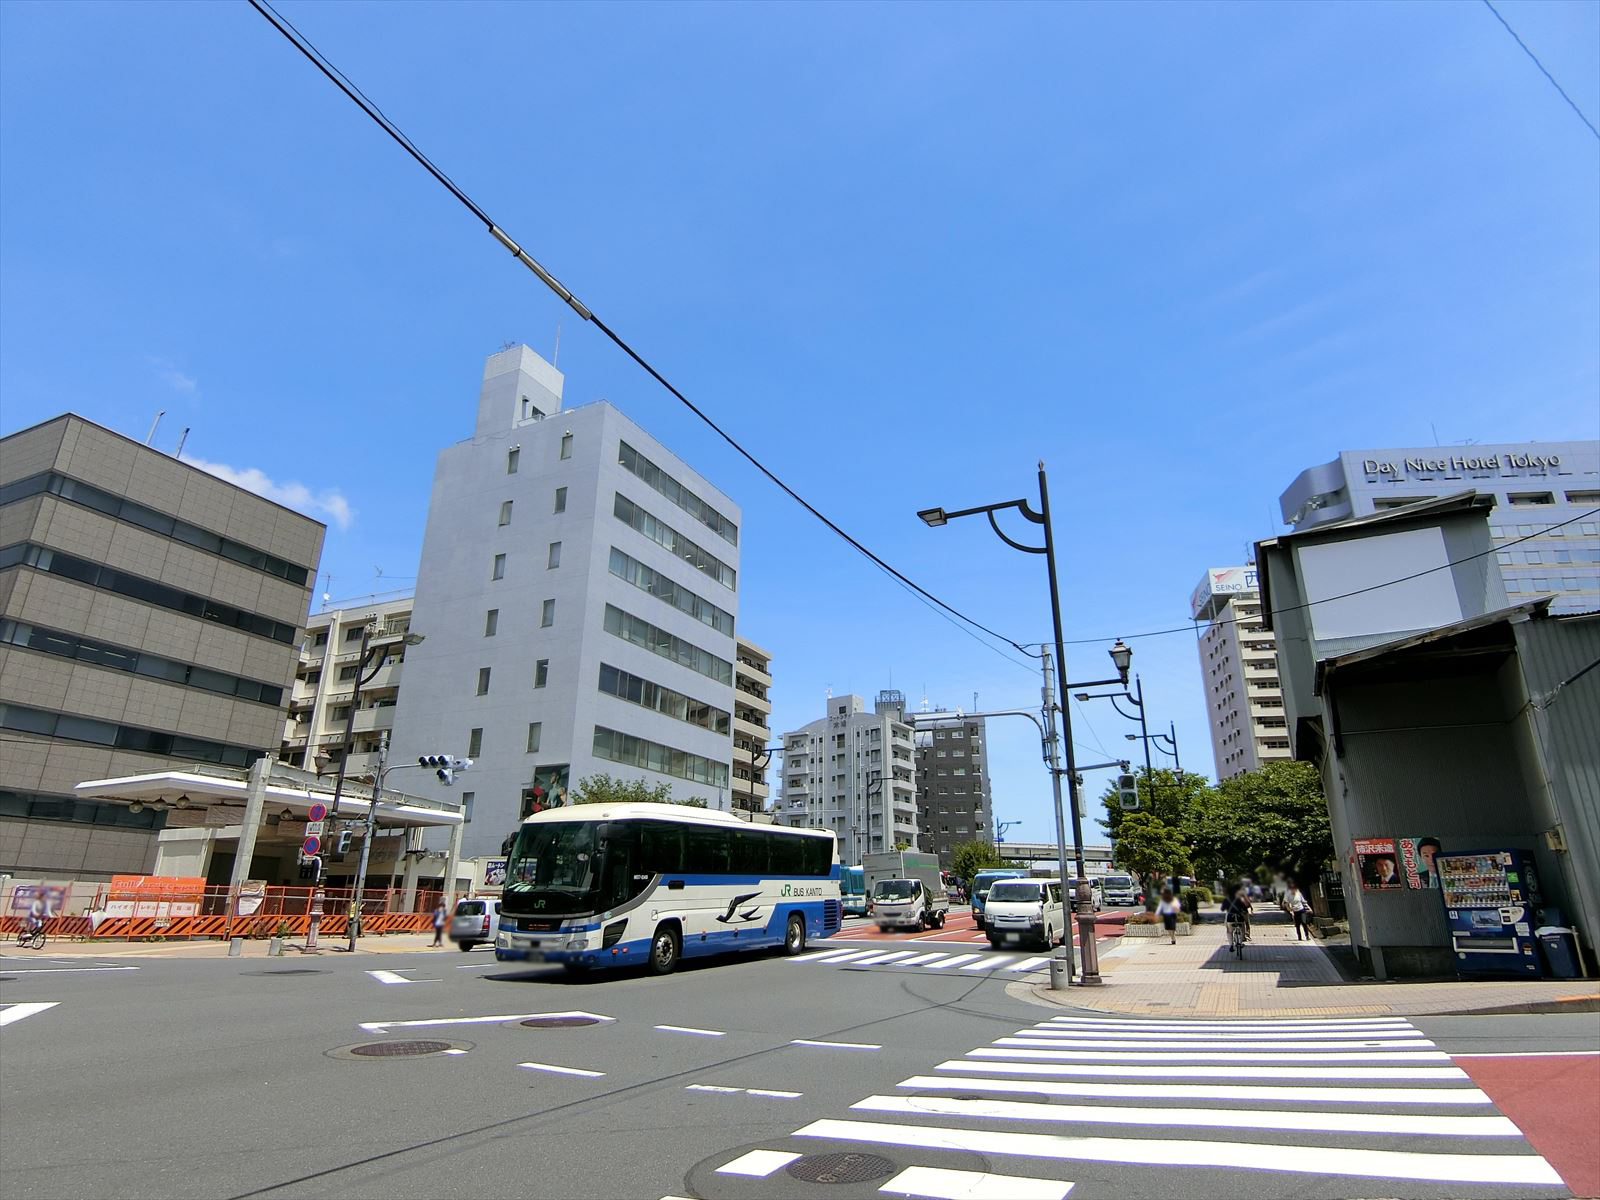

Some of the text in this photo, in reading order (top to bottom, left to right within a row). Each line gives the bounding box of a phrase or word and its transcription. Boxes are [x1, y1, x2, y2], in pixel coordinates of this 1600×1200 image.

[1363, 452, 1562, 479] Day Nice Hotel Tokyo
[1215, 583, 1242, 592] SEINO
[781, 883, 822, 897] JR BUS KANTO
[534, 899, 546, 909] JR
